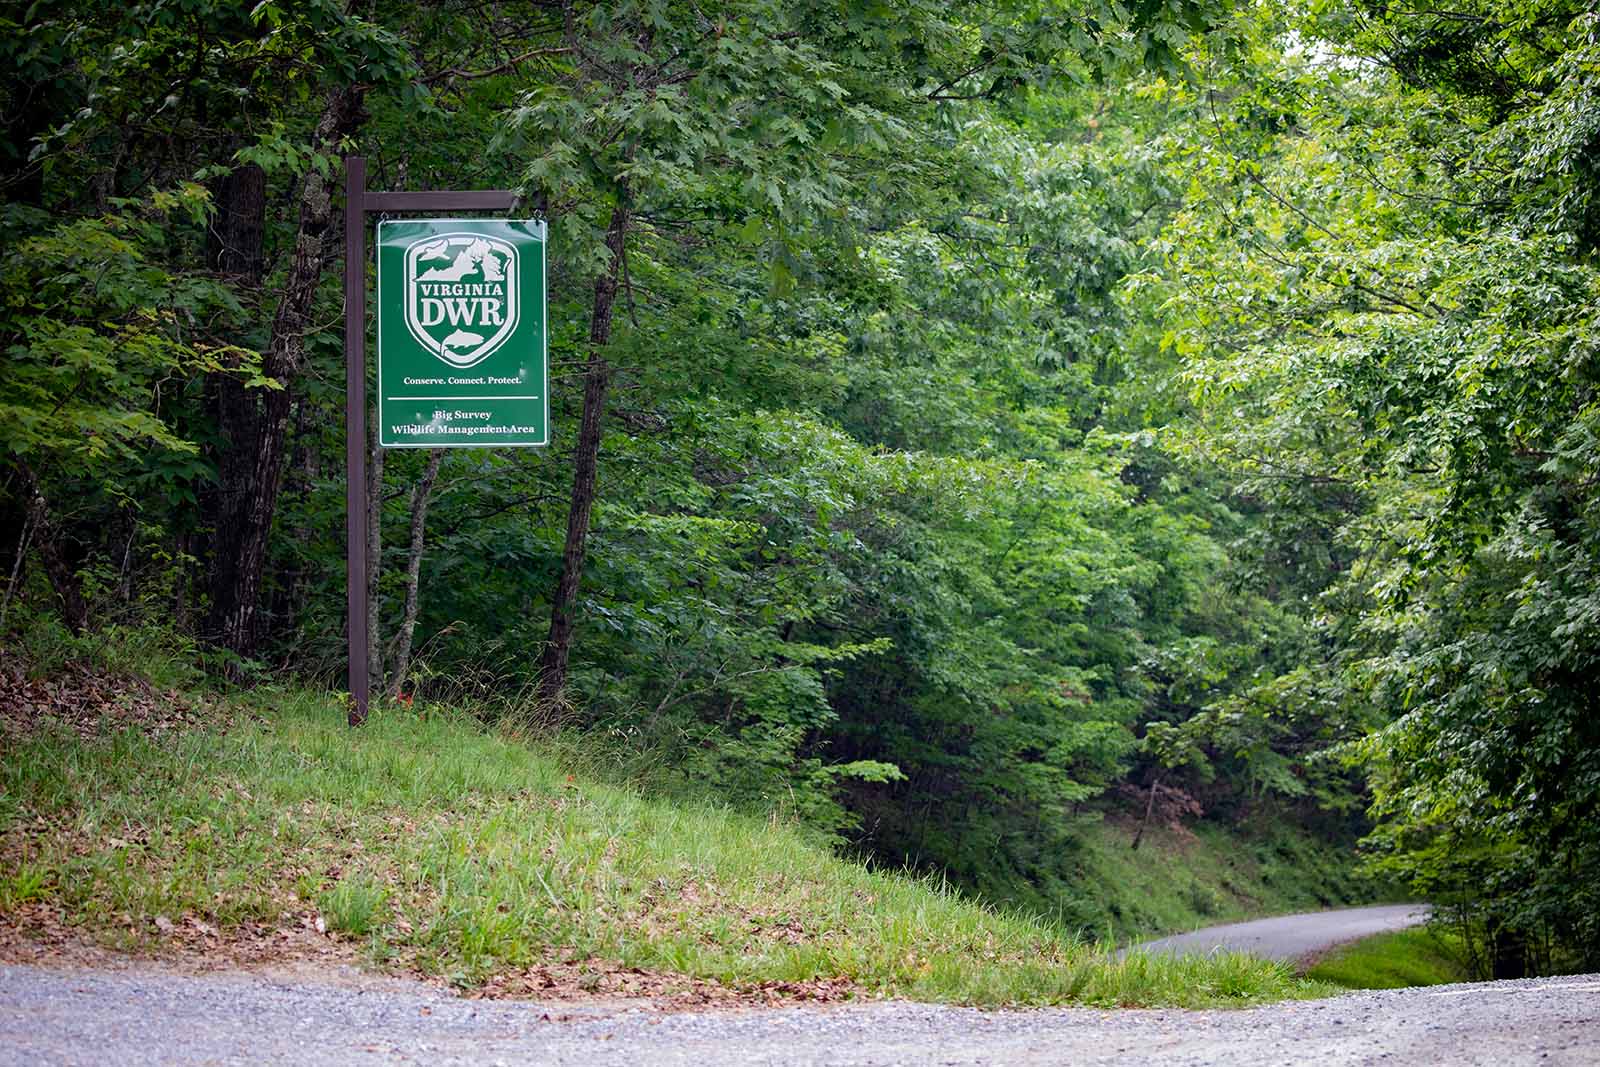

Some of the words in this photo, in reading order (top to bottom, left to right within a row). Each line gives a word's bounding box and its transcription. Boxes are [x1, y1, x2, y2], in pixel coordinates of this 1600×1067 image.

[421, 284, 503, 296] VIRGINIA
[421, 298, 504, 326] DWR
[404, 377, 446, 385] Conserve.
[448, 377, 486, 385] Connect.
[488, 377, 522, 385] Protect.
[434, 411, 453, 421] Big
[454, 411, 492, 420] Survey
[392, 425, 435, 434] Wildlife
[438, 425, 506, 435] Management
[508, 425, 534, 433] Area
